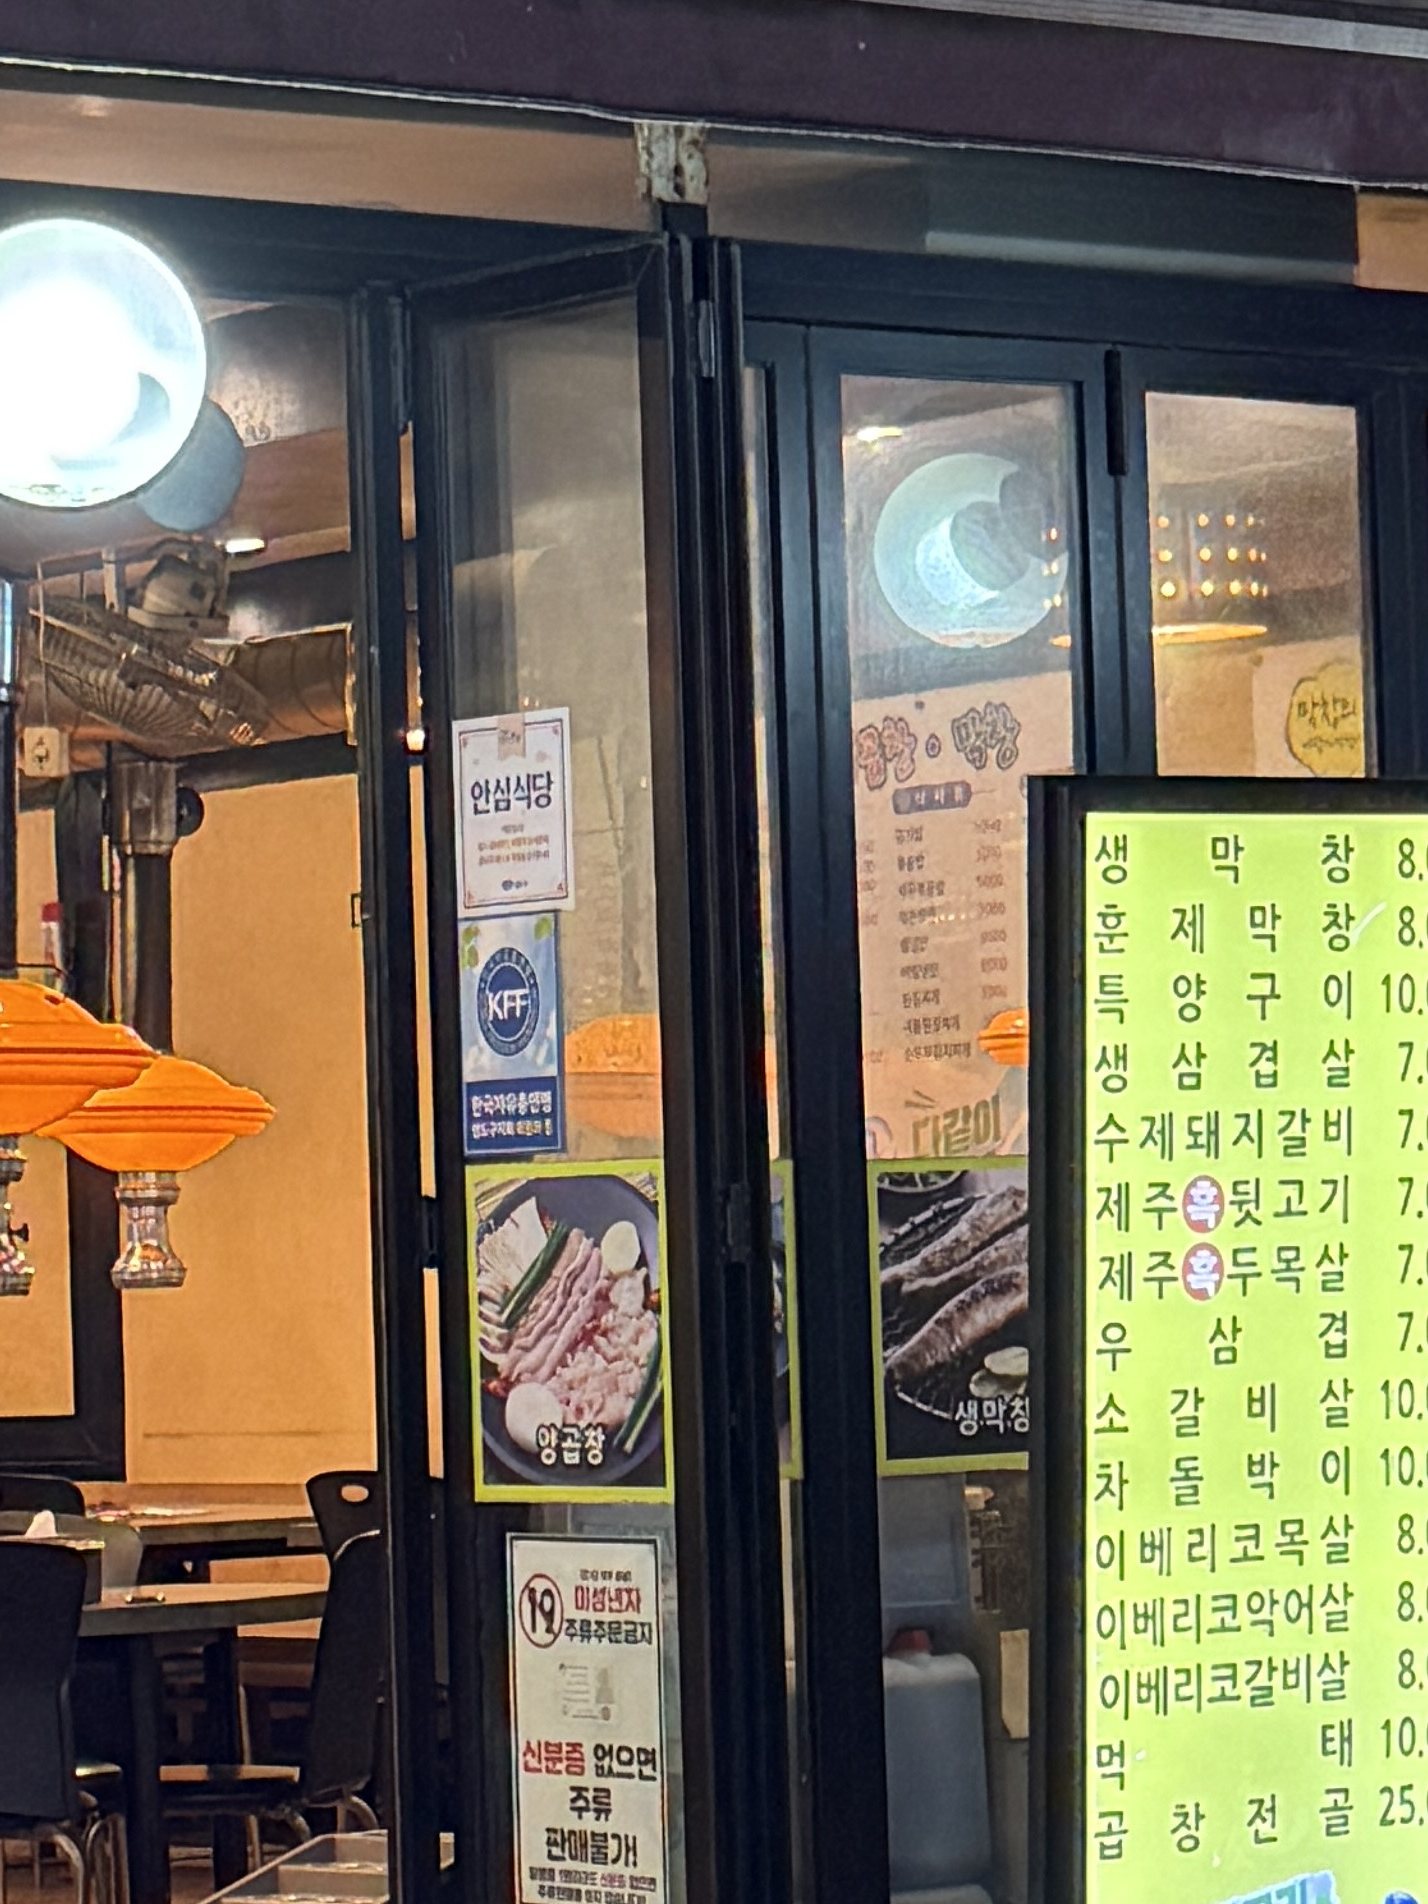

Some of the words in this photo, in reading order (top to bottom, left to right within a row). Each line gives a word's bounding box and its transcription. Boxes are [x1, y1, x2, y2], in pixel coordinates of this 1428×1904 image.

[470, 770, 555, 816] 안심식당
[487, 987, 530, 1023] KFF
[1093, 1106, 1353, 1164] 수제돼지갈비
[536, 1423, 605, 1466] 양곱창
[1095, 1513, 1355, 1582] 이베리코목살
[528, 1586, 556, 1635] 19
[574, 1584, 642, 1614] 미성년자
[1095, 1581, 1355, 1651] 이베리코악어살
[1098, 1649, 1352, 1721] 이베리코갈비살
[522, 1741, 586, 1776] 신분증
[593, 1743, 658, 1783] 없으면
[568, 1785, 612, 1822] 주류
[544, 1826, 638, 1868] 판매불가!
